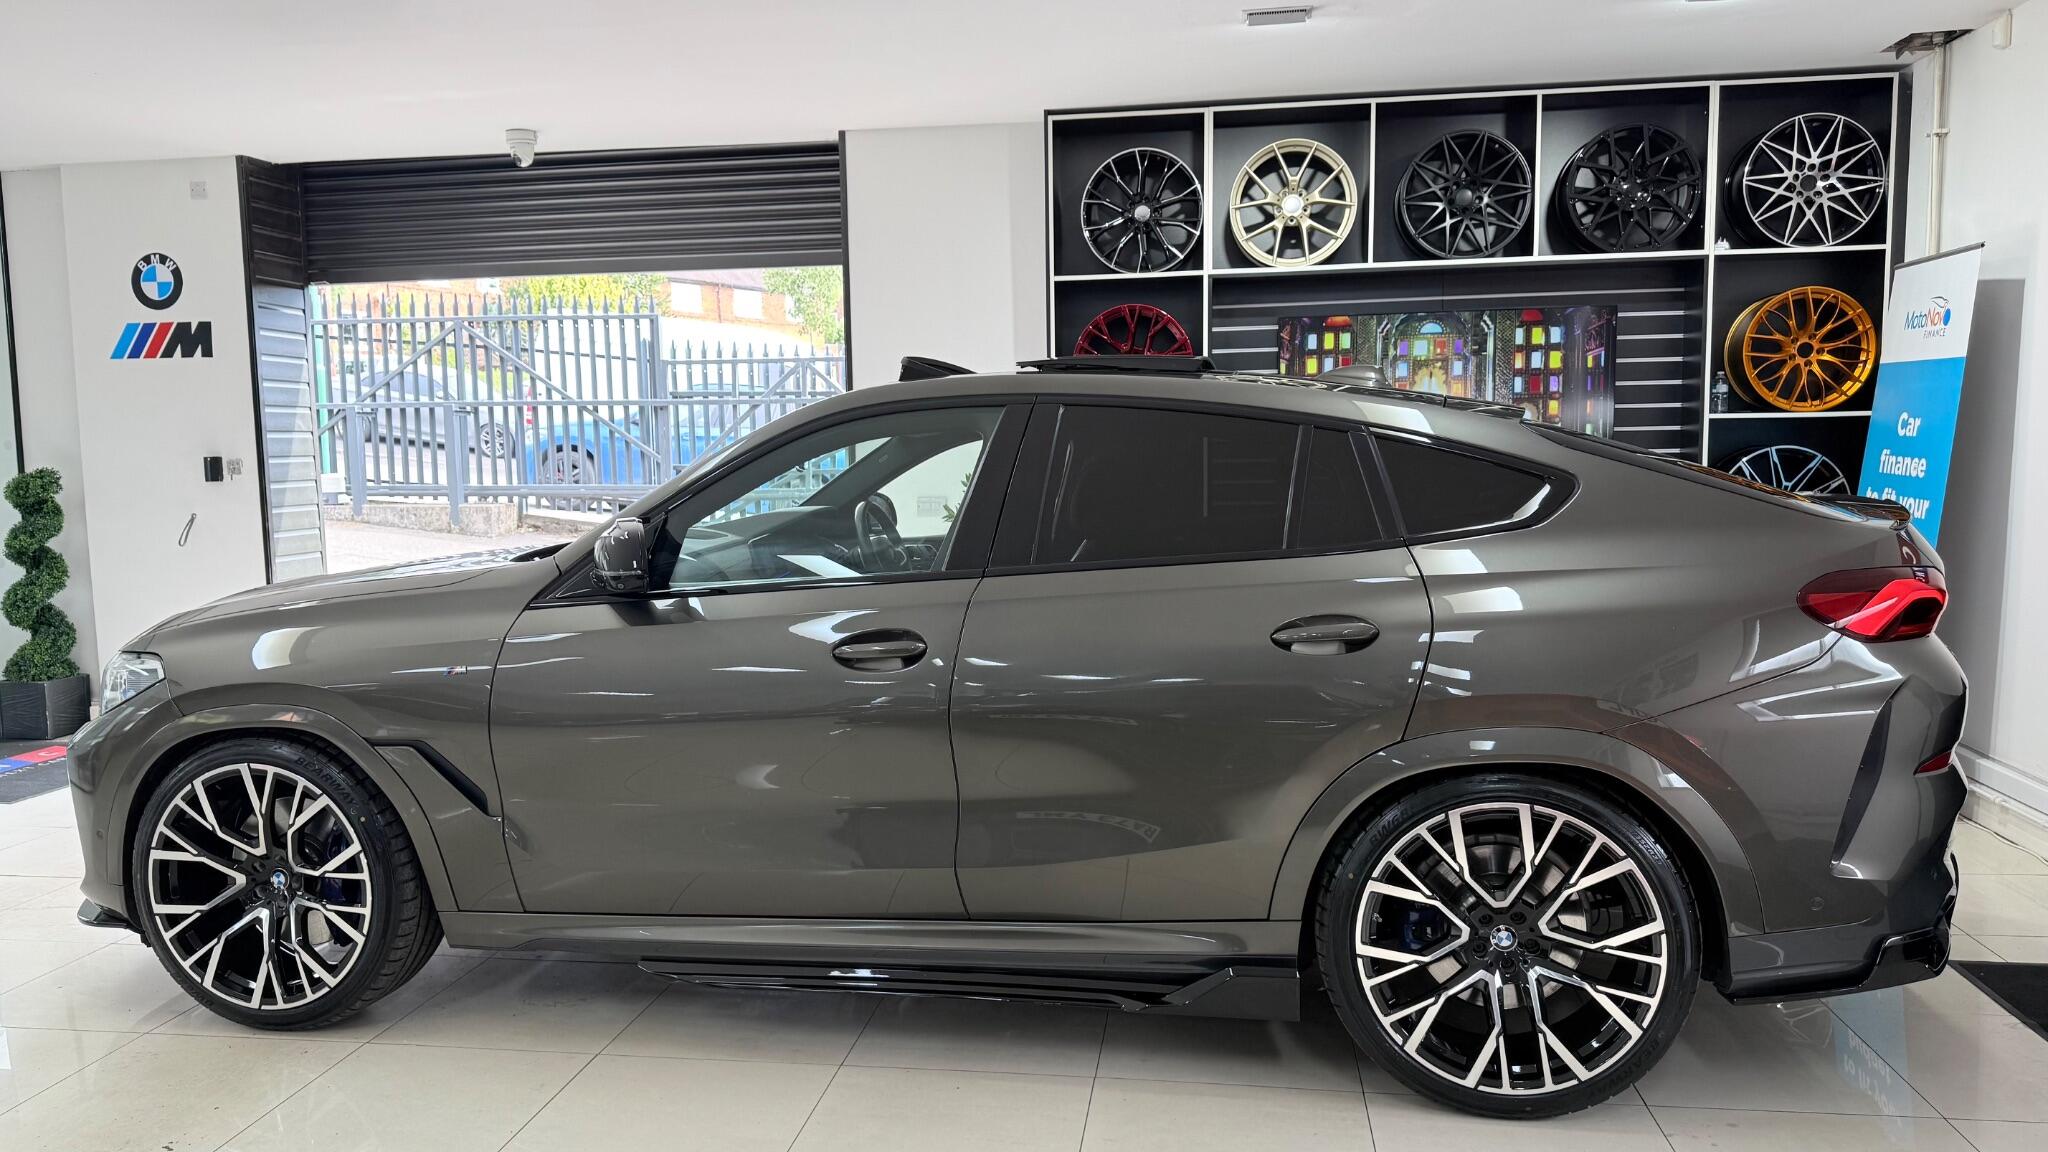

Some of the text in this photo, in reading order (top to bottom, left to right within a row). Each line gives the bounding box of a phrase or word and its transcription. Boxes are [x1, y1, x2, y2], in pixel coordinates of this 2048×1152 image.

[138, 255, 176, 272] BMW
[1923, 327, 1947, 339] FINANCE
[1897, 411, 1921, 437] Car
[1879, 448, 1926, 479] finance
